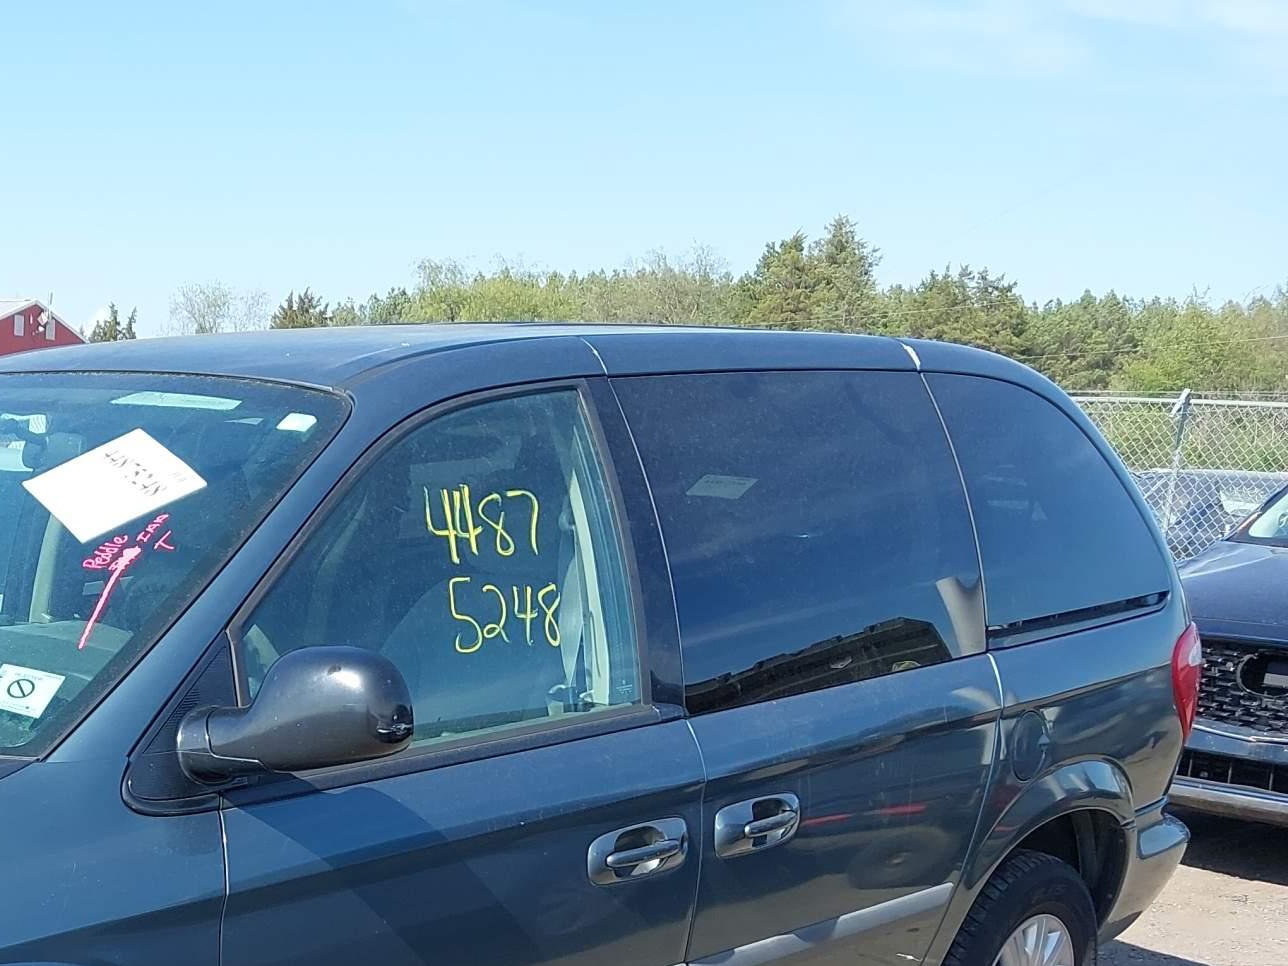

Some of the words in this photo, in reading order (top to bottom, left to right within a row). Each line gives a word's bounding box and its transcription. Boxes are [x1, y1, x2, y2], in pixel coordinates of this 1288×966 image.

[82, 534, 128, 569] Peddle
[423, 483, 540, 565] 4487
[448, 576, 561, 654] 5248
